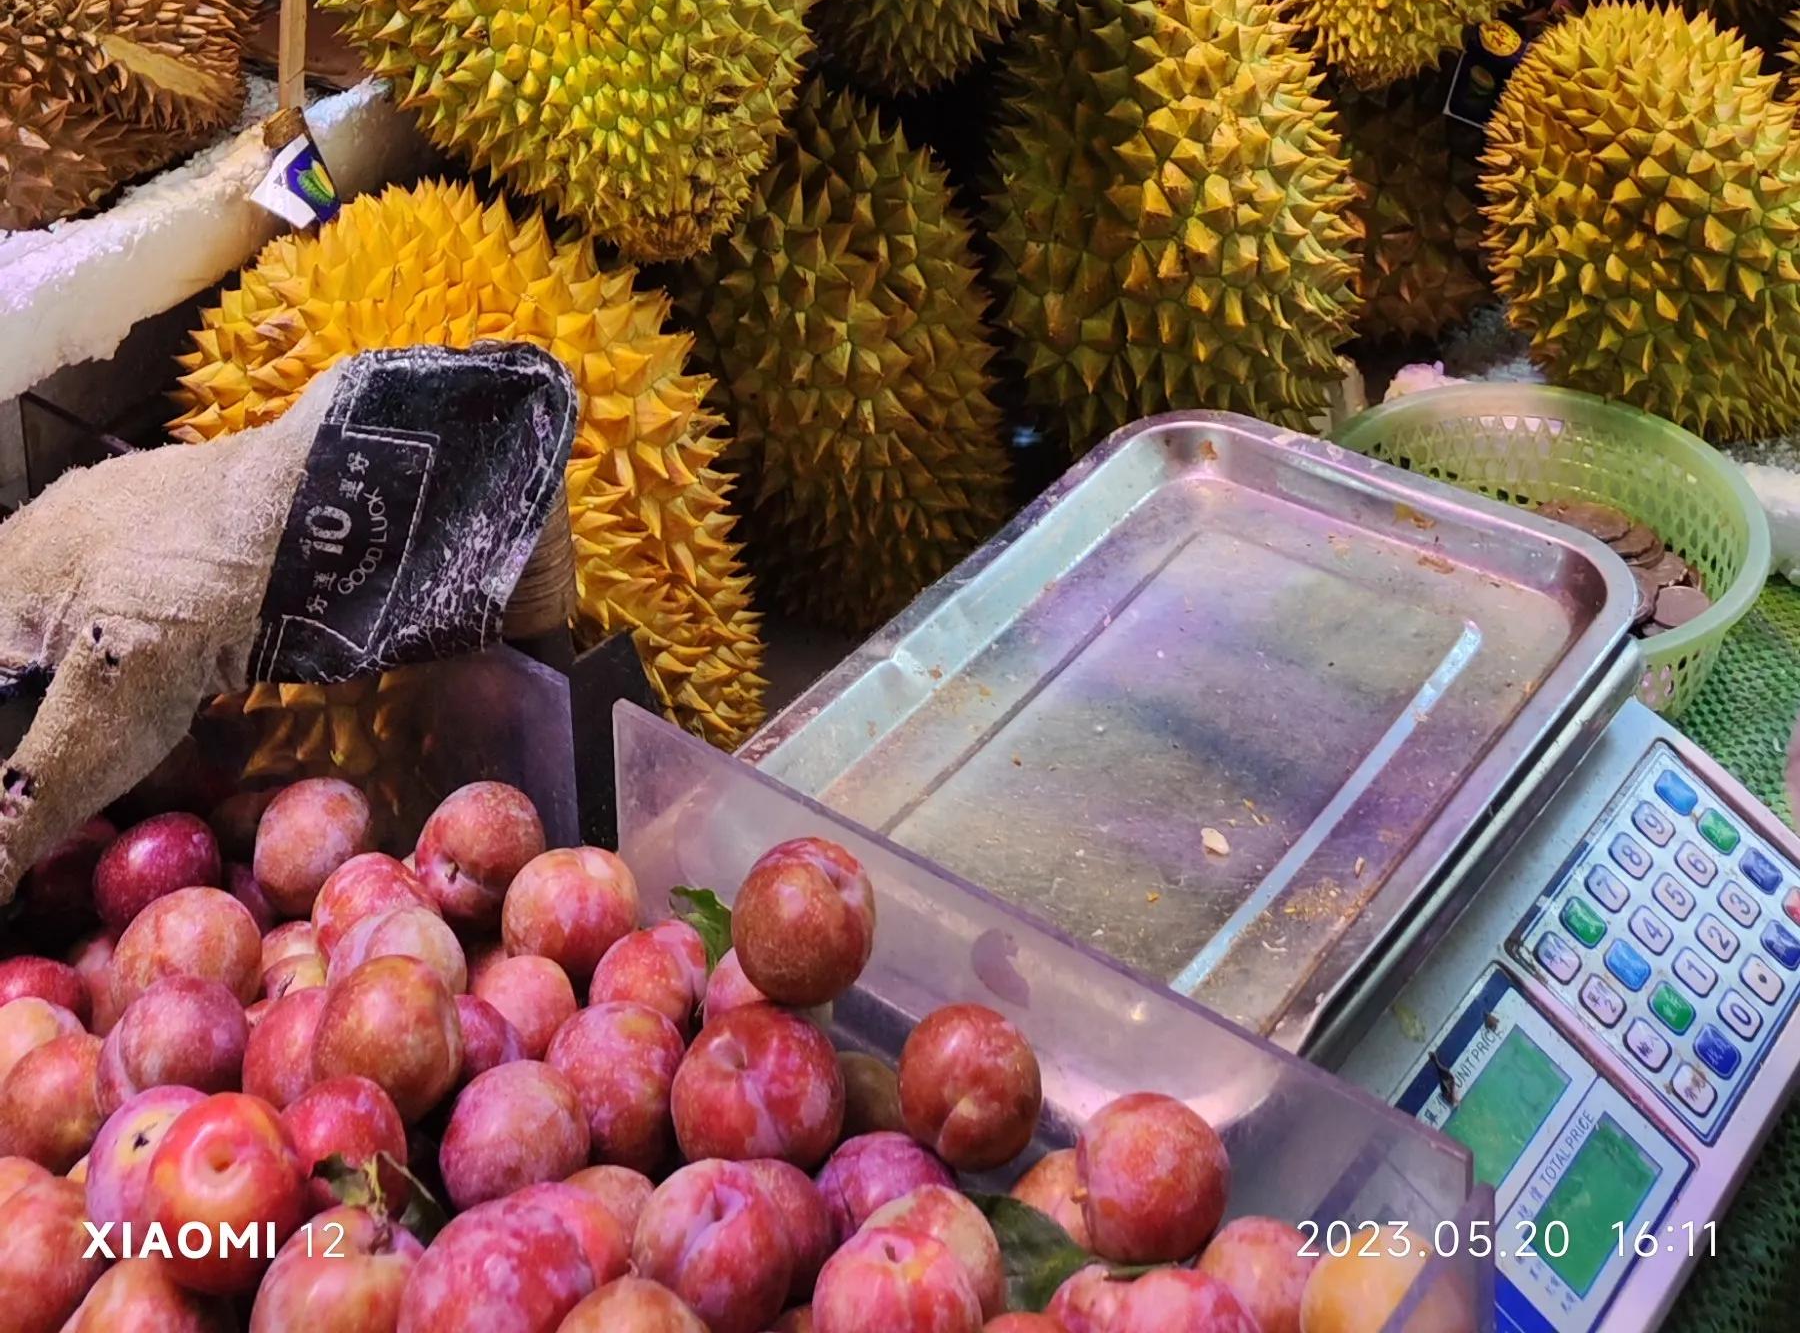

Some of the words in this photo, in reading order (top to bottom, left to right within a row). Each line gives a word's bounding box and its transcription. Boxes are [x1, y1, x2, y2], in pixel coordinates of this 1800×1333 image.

[304, 504, 352, 556] 10
[337, 546, 383, 595] GOOD
[363, 486, 388, 544] LUCK
[1595, 878, 1618, 901] 7
[1622, 845, 1643, 868] 8
[1644, 814, 1665, 835] 9
[1642, 917, 1664, 941] 4
[1665, 885, 1687, 908] 5
[1688, 852, 1708, 875] 6
[1685, 958, 1708, 983] 1
[1707, 925, 1731, 951] 2
[1729, 891, 1751, 912] 3
[1730, 1002, 1752, 1026] 0
[1454, 1047, 1478, 1088] UNIT
[1539, 1142, 1574, 1186] TOTAL
[1566, 1109, 1596, 1150] PRICE
